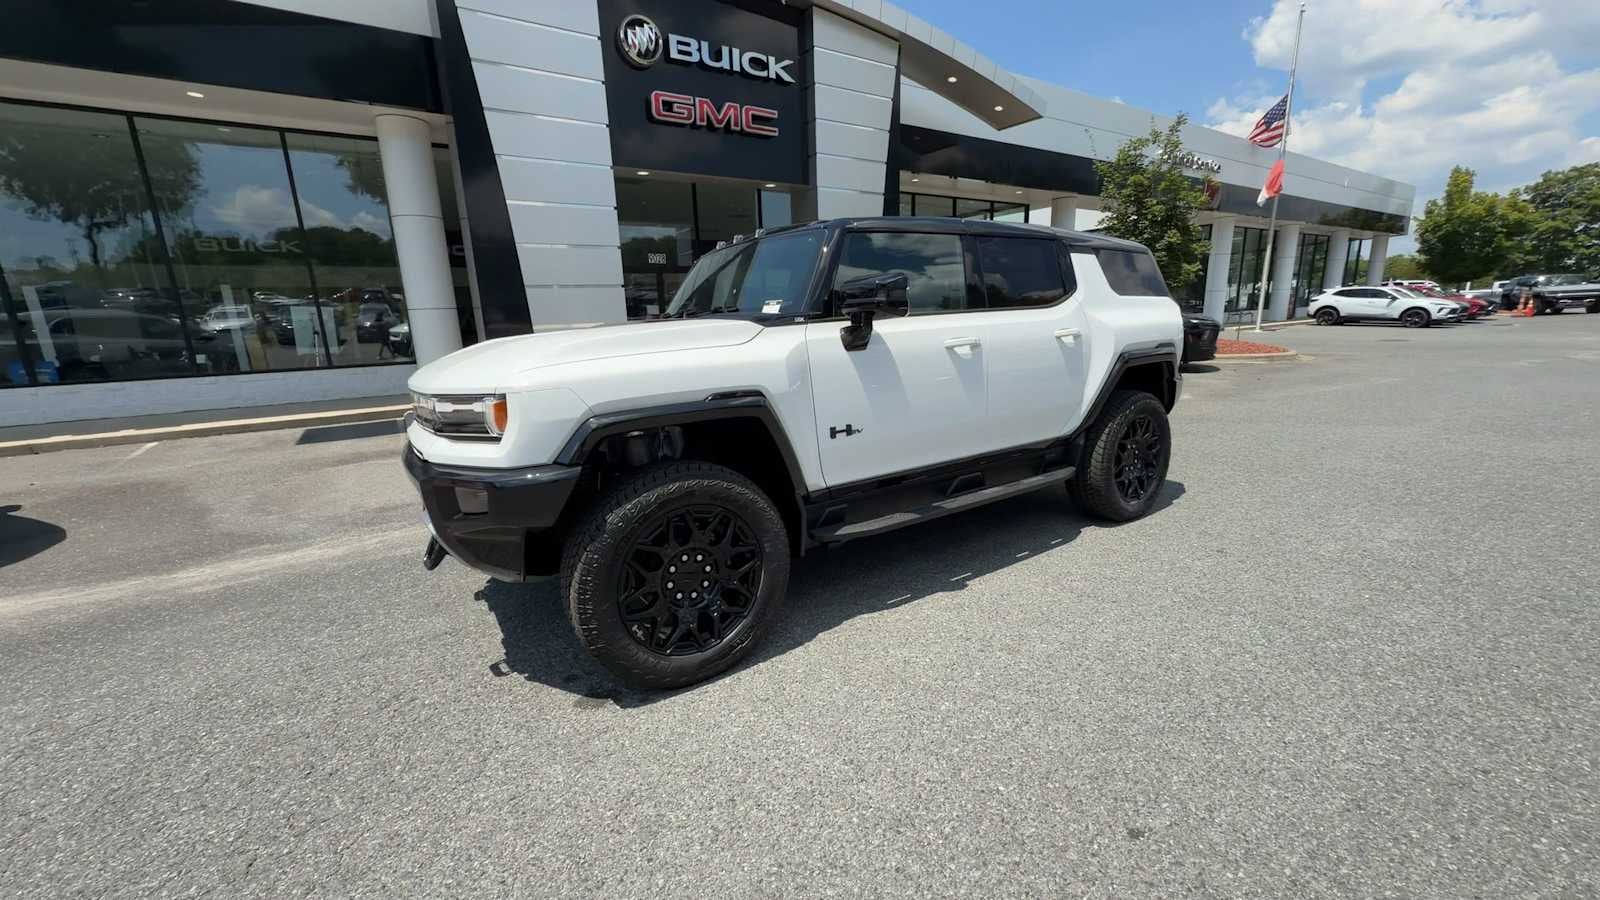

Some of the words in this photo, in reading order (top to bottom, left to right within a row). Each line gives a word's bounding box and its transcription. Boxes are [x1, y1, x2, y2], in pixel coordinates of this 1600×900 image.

[668, 33, 796, 83] BUICK
[651, 90, 779, 136] GMC
[194, 238, 304, 253] BUICK
